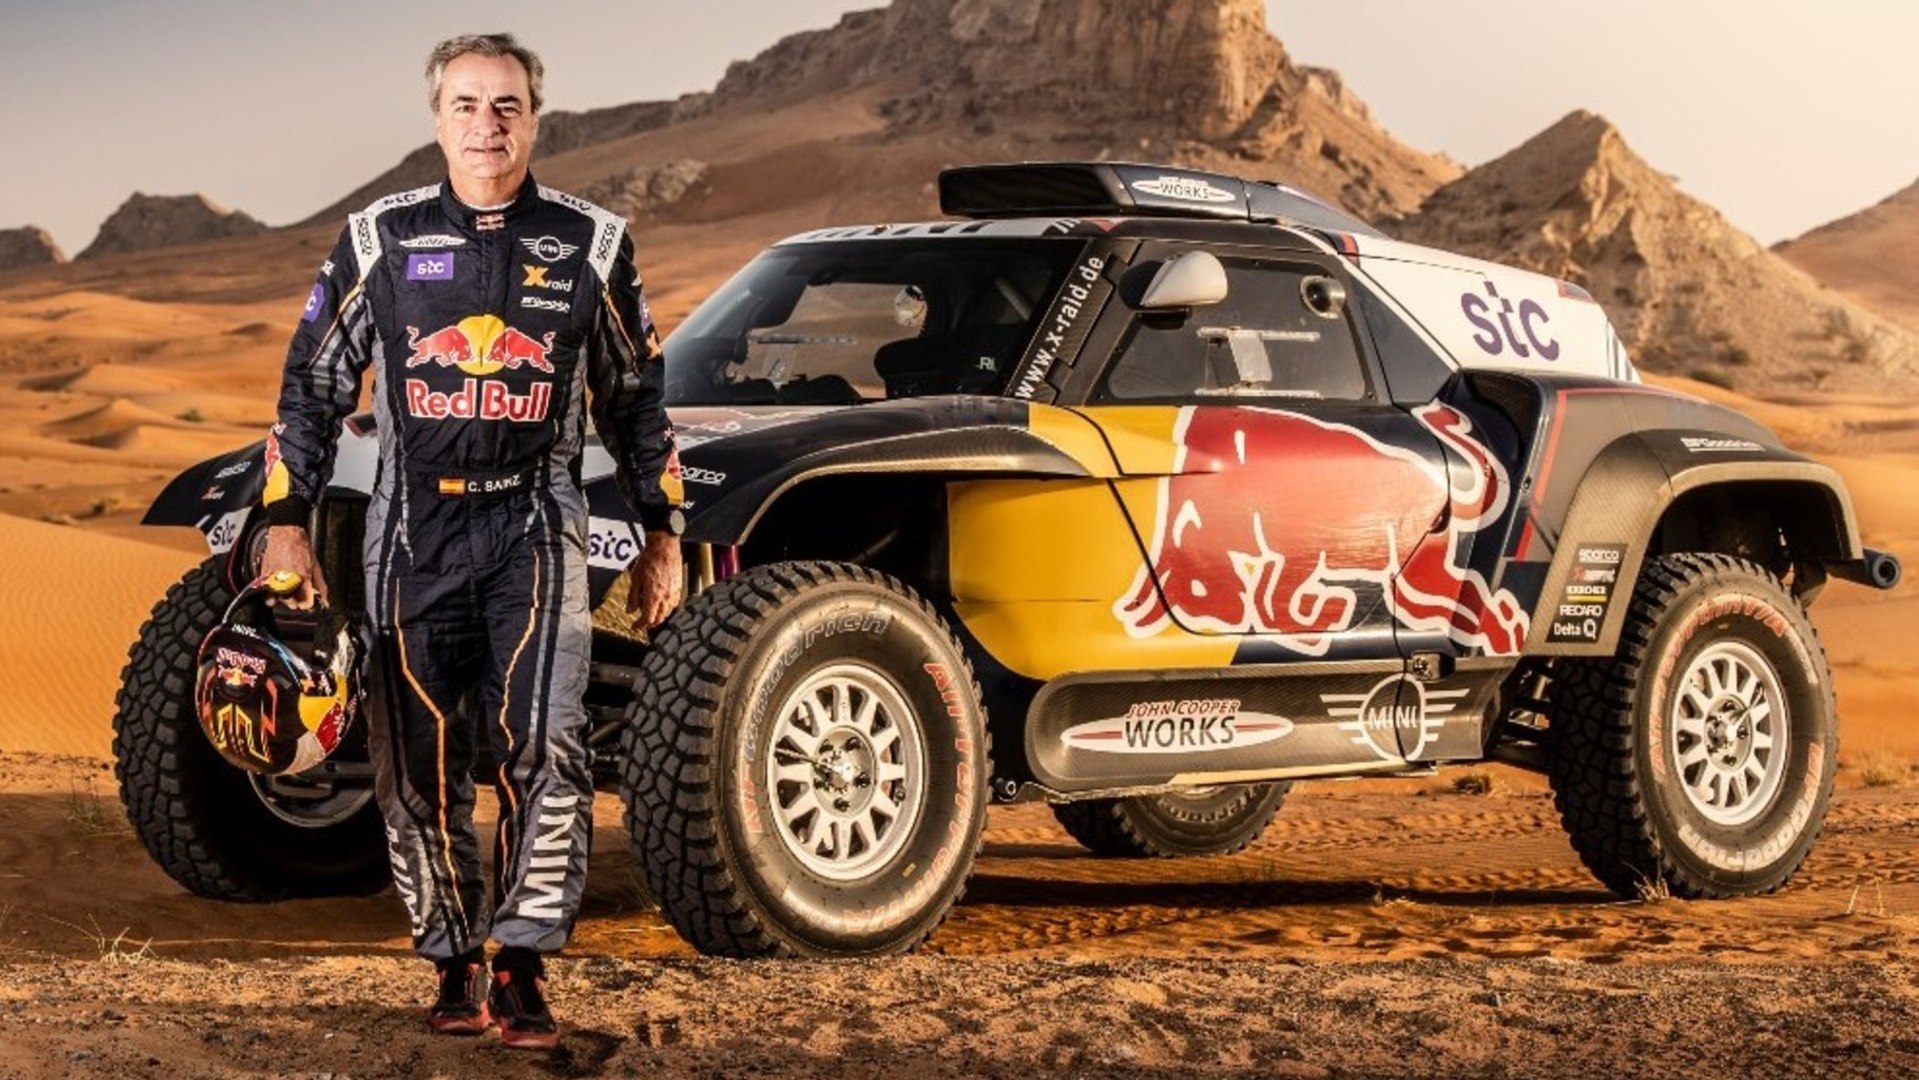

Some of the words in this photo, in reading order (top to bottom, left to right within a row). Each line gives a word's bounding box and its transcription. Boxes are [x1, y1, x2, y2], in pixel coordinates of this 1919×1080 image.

[417, 260, 445, 275] stc
[1015, 257, 1104, 399] www.x-raid.de
[1461, 281, 1559, 361] stc
[406, 378, 477, 419] Red
[480, 380, 552, 422] Bull
[589, 530, 632, 561] stc
[1553, 622, 1581, 635] Delta
[1583, 618, 1597, 640] Q
[1125, 701, 1175, 719] JOHN
[1177, 698, 1240, 716] COOPER
[1368, 705, 1417, 730] MINI
[1125, 716, 1235, 748] WORKS
[517, 795, 581, 919] MINI
